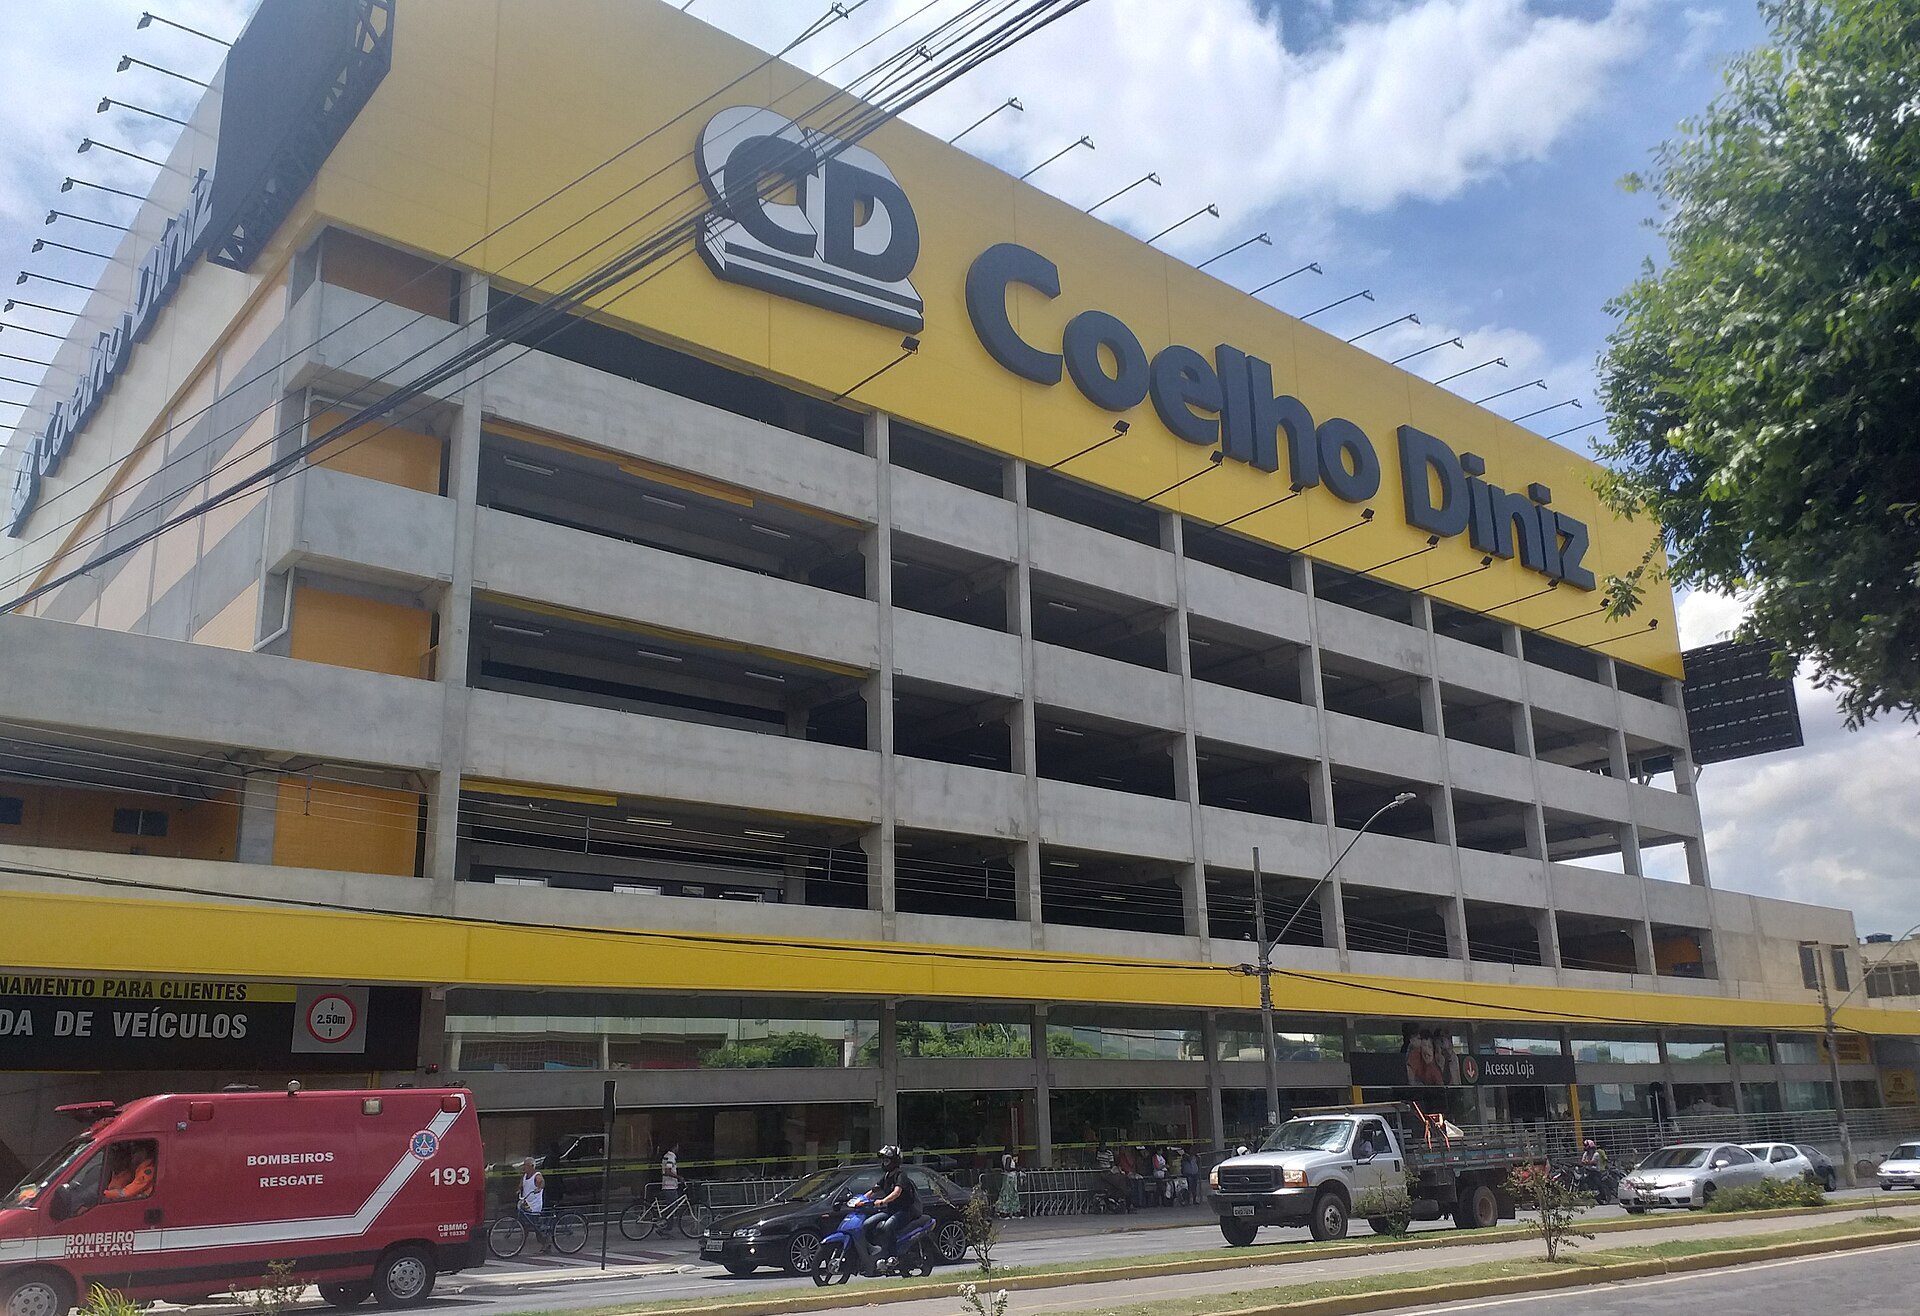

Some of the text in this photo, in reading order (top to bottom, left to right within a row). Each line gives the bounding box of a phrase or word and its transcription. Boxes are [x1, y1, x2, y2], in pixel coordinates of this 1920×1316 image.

[695, 105, 922, 284] CD
[965, 242, 1597, 593] Coelho Diniz
[102, 980, 154, 999] PARA
[160, 981, 248, 1001] CLIENTES
[54, 1010, 94, 1037] DE
[112, 1006, 248, 1039] VEÍCULOS
[317, 1014, 346, 1025] 2.50m
[1485, 1060, 1535, 1079] Acesso Loja
[246, 1151, 335, 1167] BOMBEIROS
[259, 1174, 324, 1188] RESGATE
[429, 1166, 470, 1187] 193
[437, 1222, 468, 1232] CBMMG
[66, 1230, 135, 1246] BOMBEIRO
[65, 1242, 133, 1255] MILITAR
